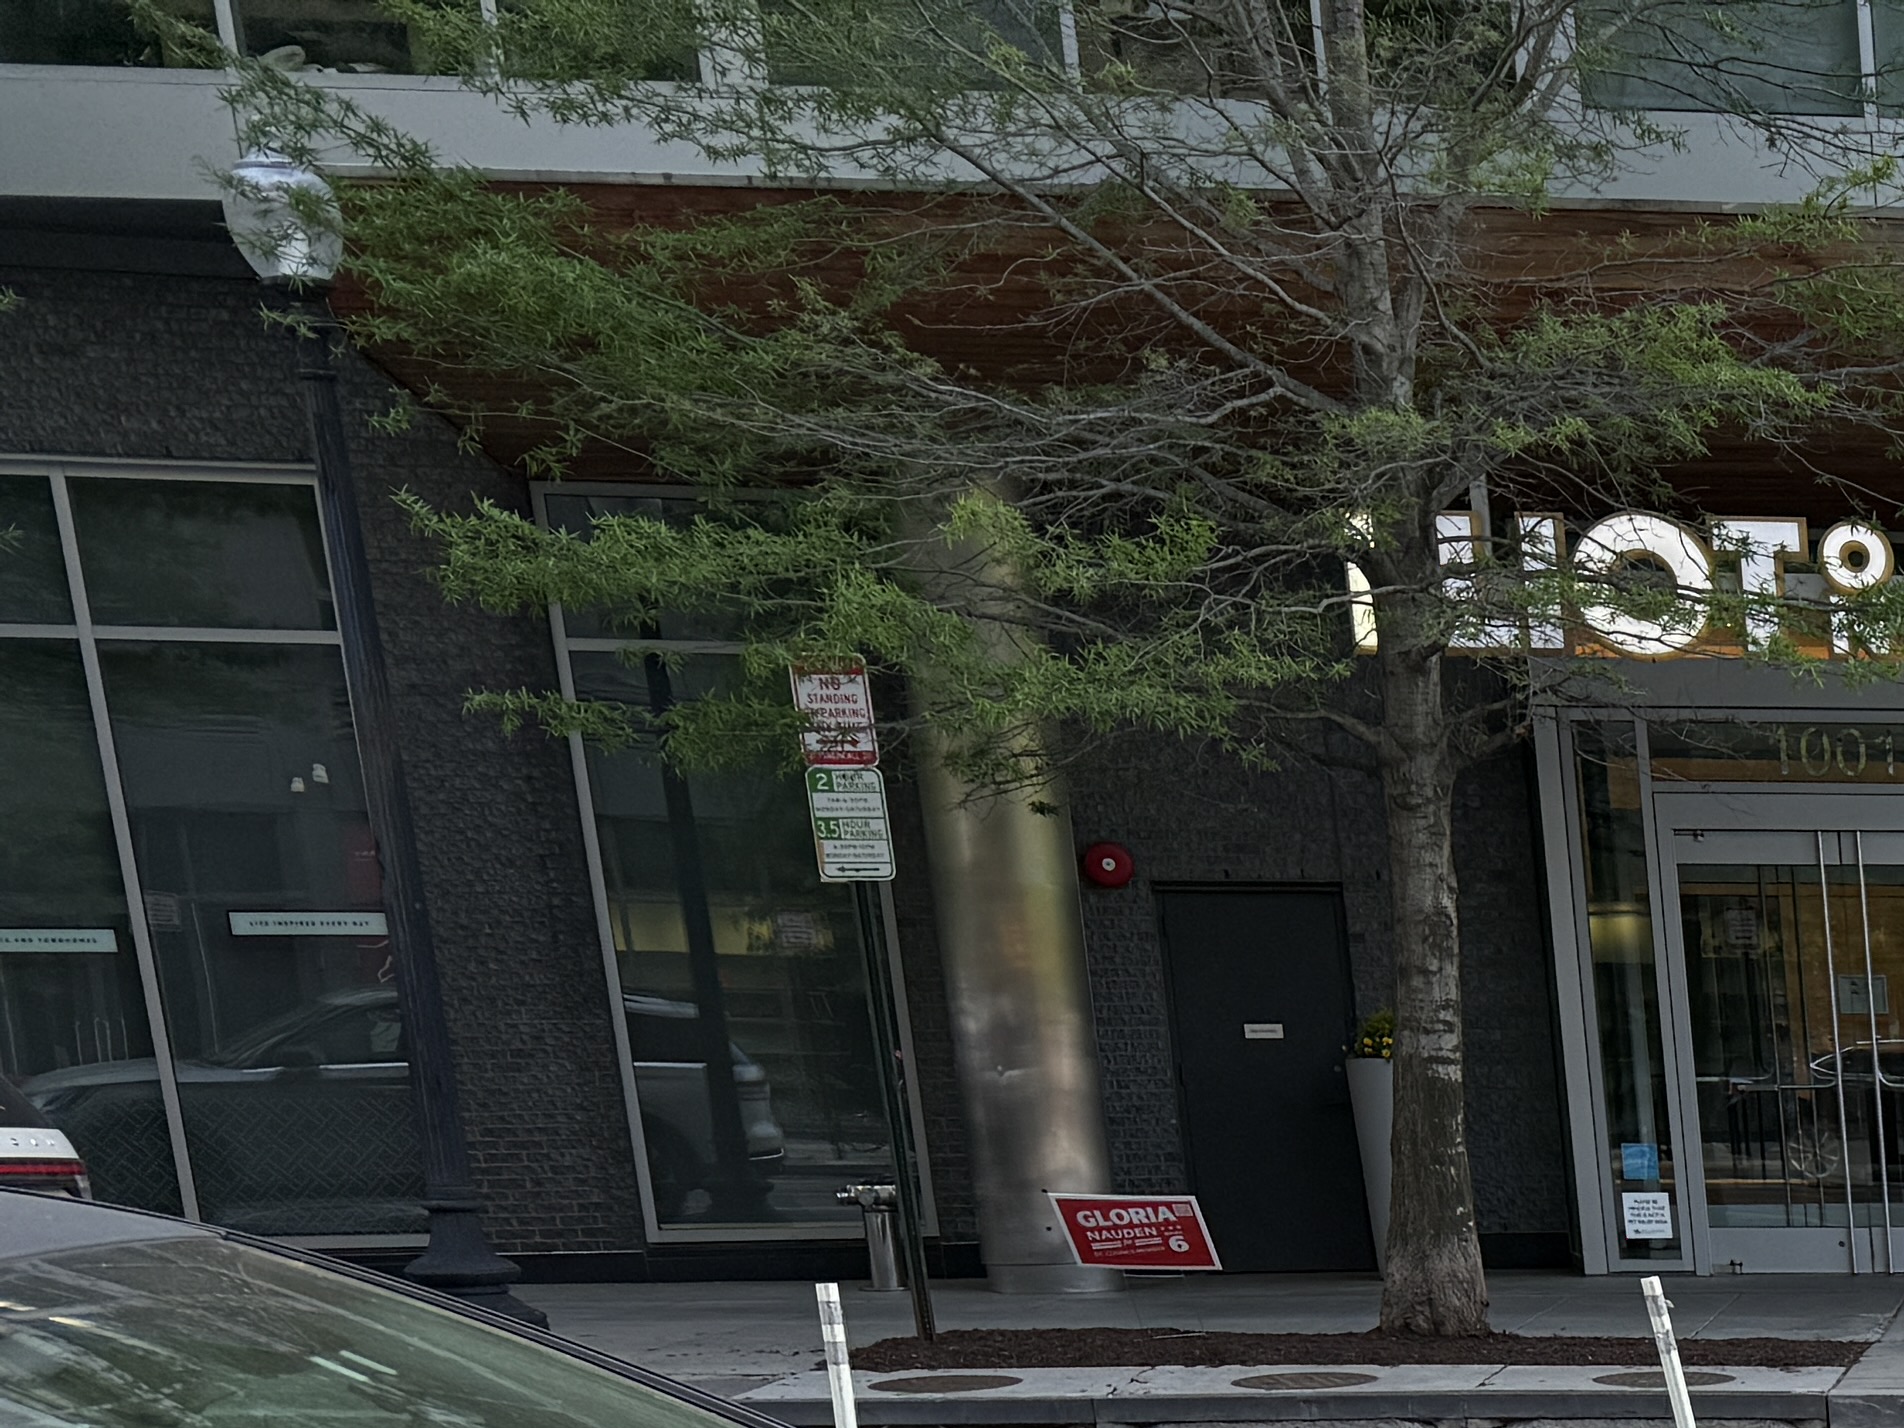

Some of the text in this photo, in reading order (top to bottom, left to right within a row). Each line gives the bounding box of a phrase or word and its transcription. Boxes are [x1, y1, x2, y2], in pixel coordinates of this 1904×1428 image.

[819, 677, 841, 690] NO
[806, 693, 859, 704] STANDING
[1776, 725, 1895, 777] 1001
[815, 773, 830, 790] 2
[837, 781, 877, 790] PARKING
[816, 820, 871, 838] 3.5 HOUR
[843, 829, 885, 839] PARKING
[1076, 1205, 1179, 1228] GLORIA
[1086, 1226, 1158, 1241] NAUDEN
[1168, 1235, 1190, 1253] 6
